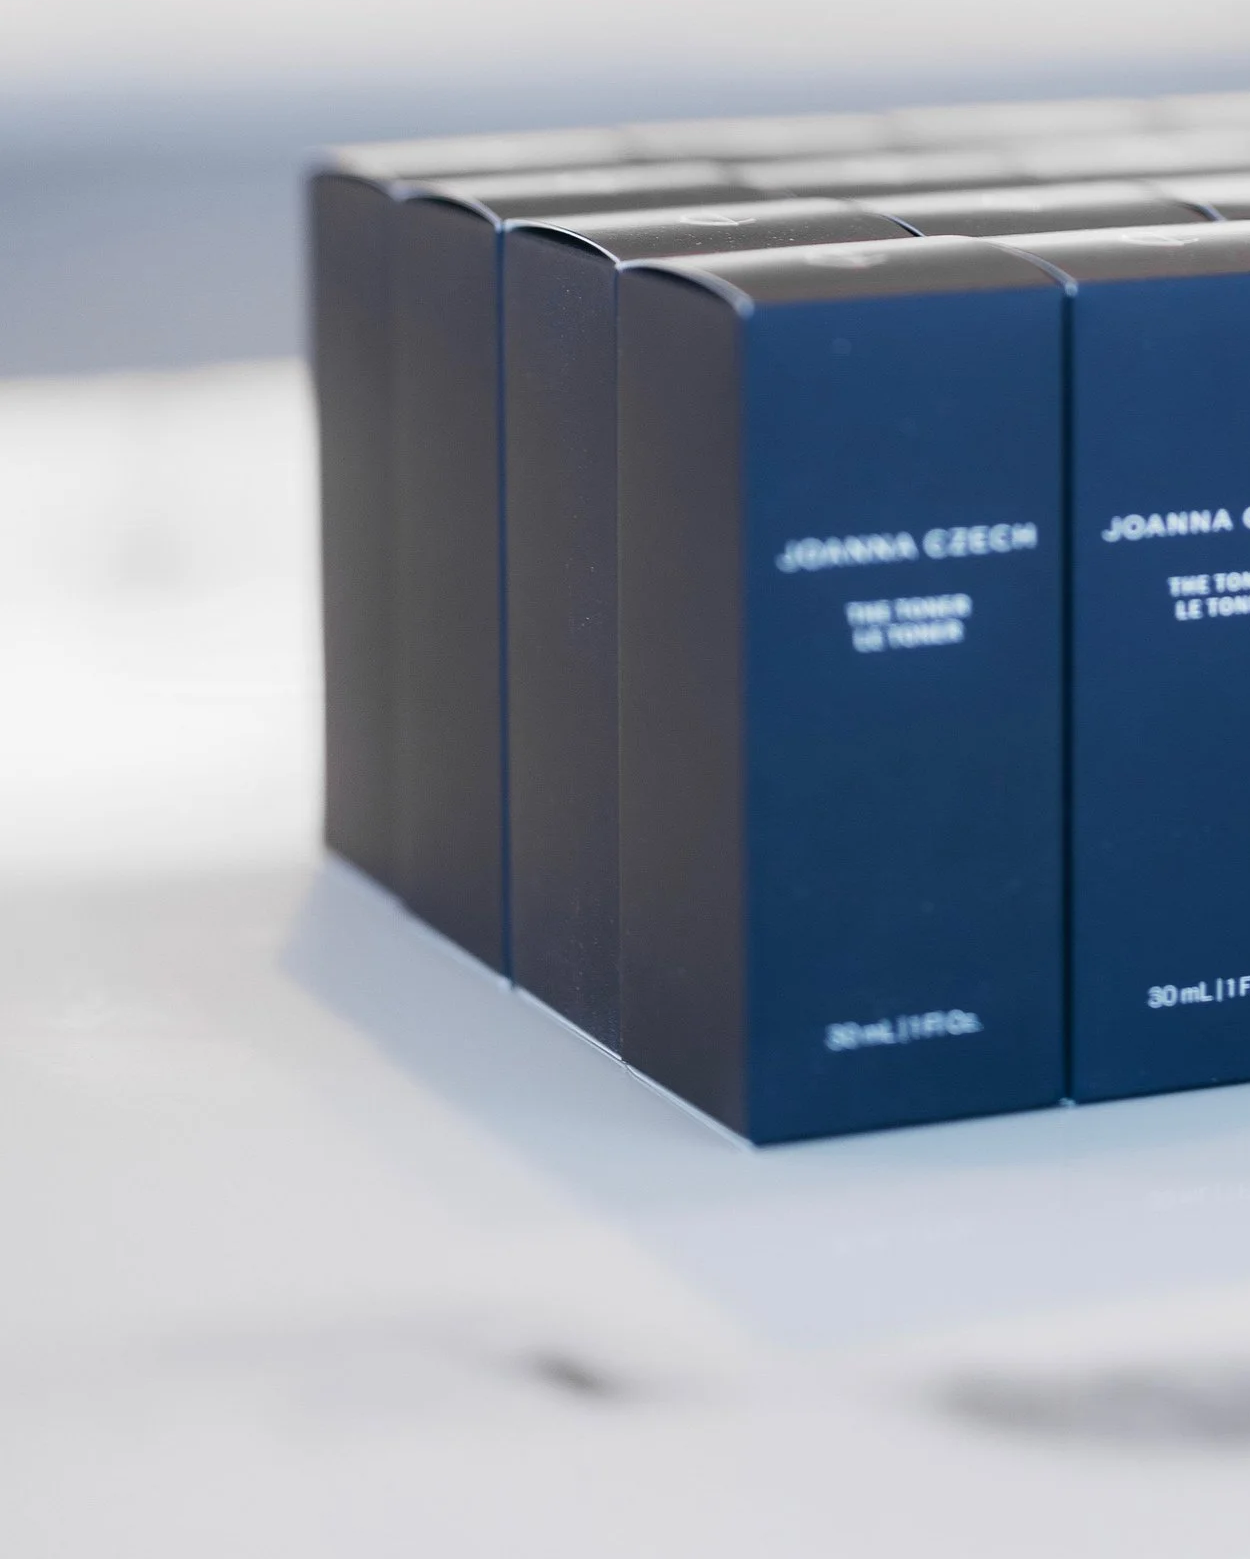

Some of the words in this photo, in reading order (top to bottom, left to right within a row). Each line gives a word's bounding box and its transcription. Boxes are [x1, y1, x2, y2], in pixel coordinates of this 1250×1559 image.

[1101, 508, 1233, 544] JOANNA
[1167, 574, 1211, 598] THE
[1175, 598, 1204, 622] LE
[1148, 984, 1178, 1008] 30
[1180, 981, 1214, 1004] mL
[1227, 978, 1236, 998] 1
